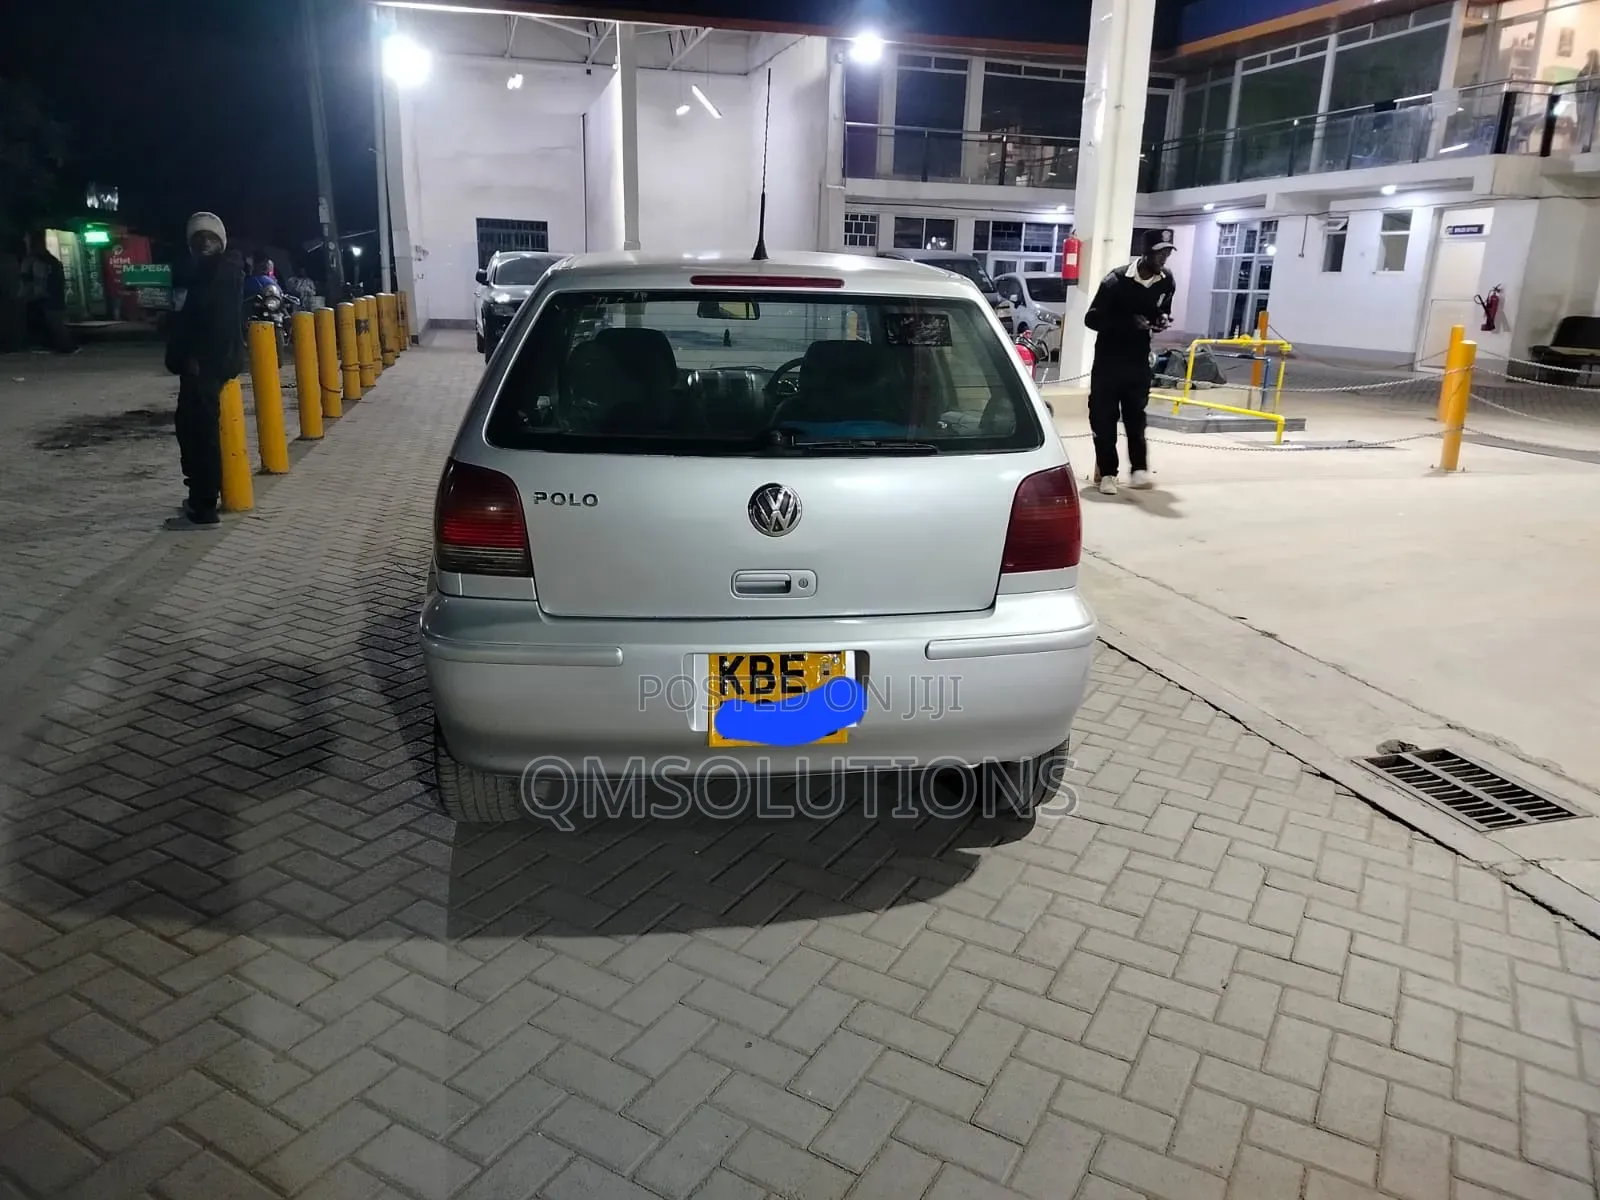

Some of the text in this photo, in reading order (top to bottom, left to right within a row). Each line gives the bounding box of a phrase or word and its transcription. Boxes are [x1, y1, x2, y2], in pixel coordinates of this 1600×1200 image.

[533, 491, 599, 507] POLO
[749, 483, 802, 537] VW
[718, 653, 808, 695] KBE
